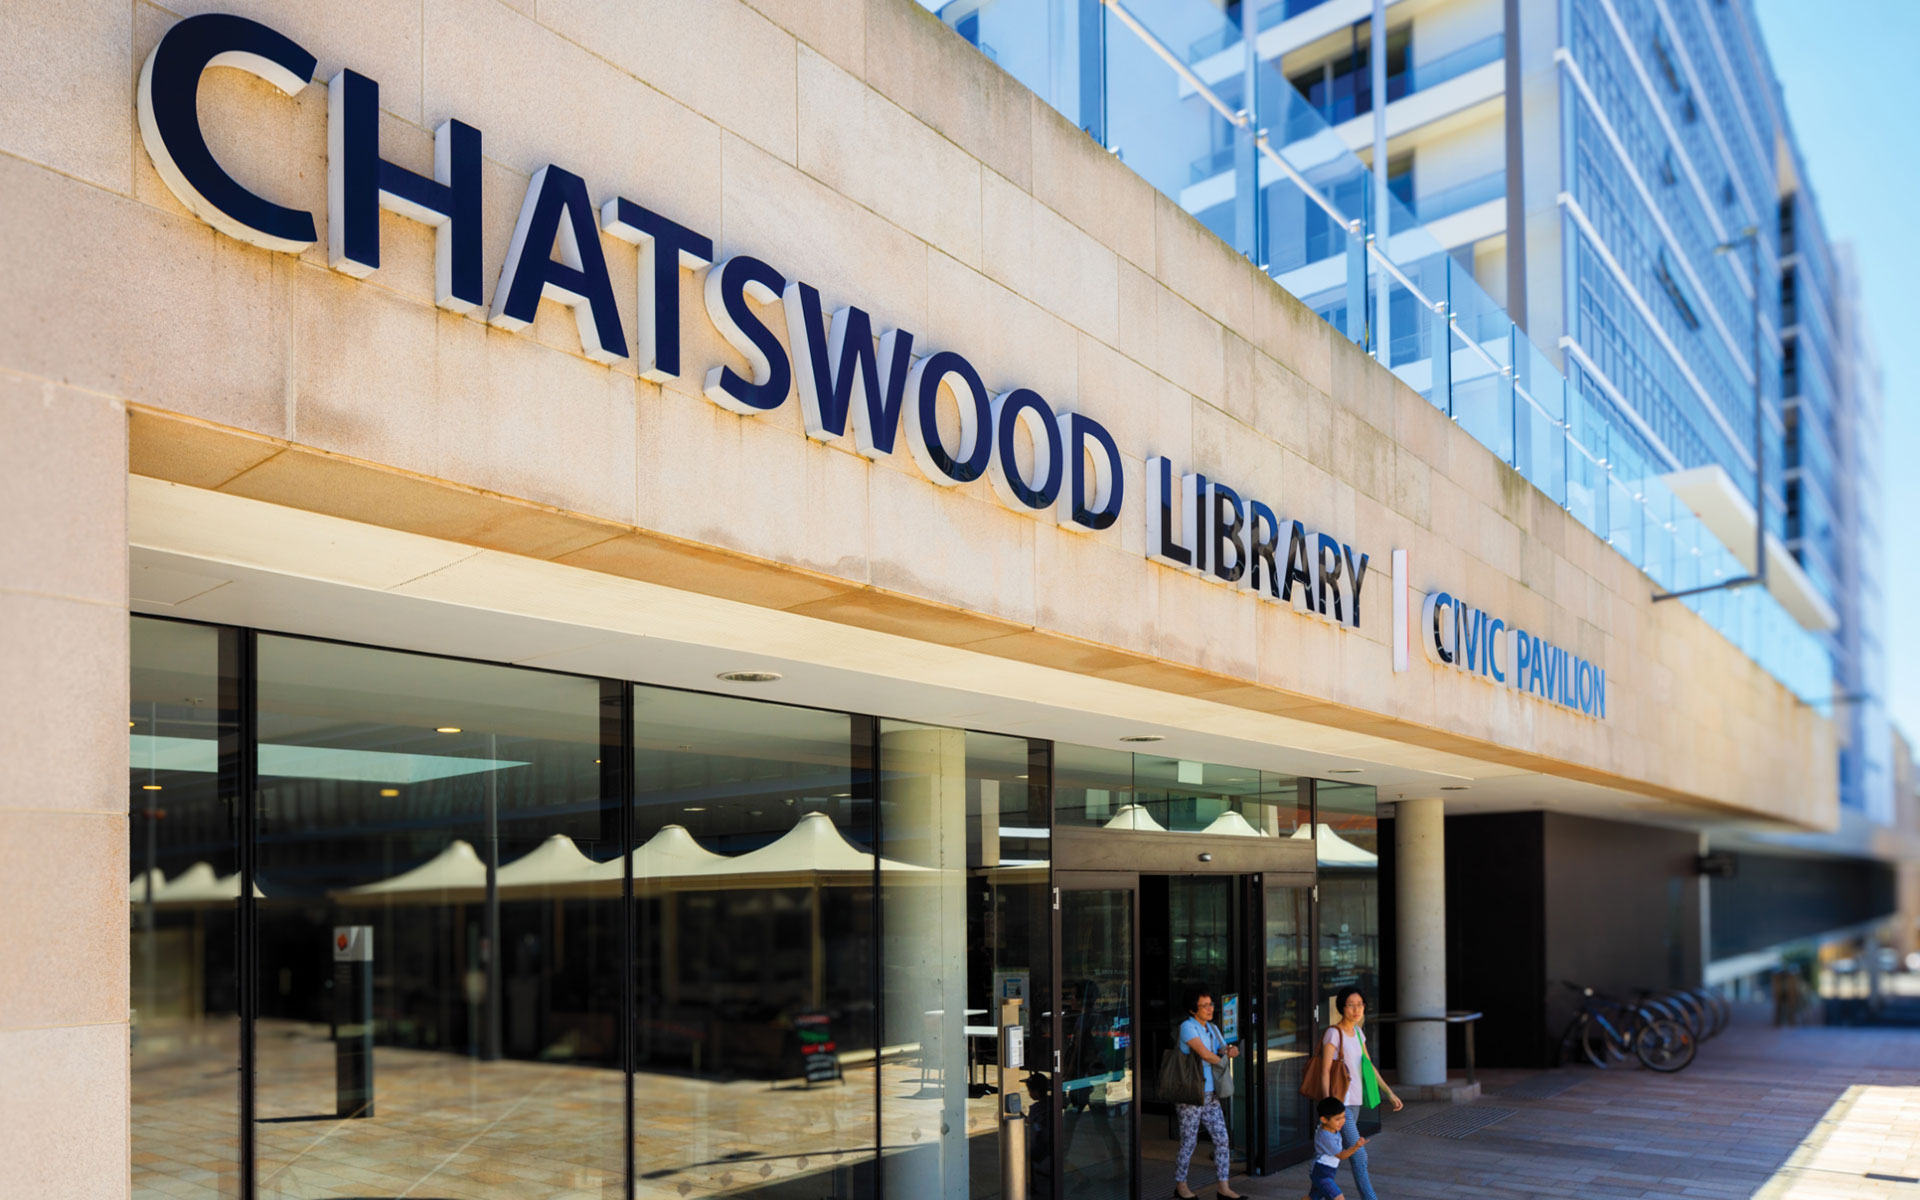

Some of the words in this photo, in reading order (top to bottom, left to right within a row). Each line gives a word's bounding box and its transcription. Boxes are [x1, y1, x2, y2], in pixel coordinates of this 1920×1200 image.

[139, 13, 1124, 531] CHATSWOOD
[1148, 455, 1370, 628] LIBRARY
[1425, 591, 1505, 683] CIVIC
[1512, 629, 1606, 719] PAVILION
